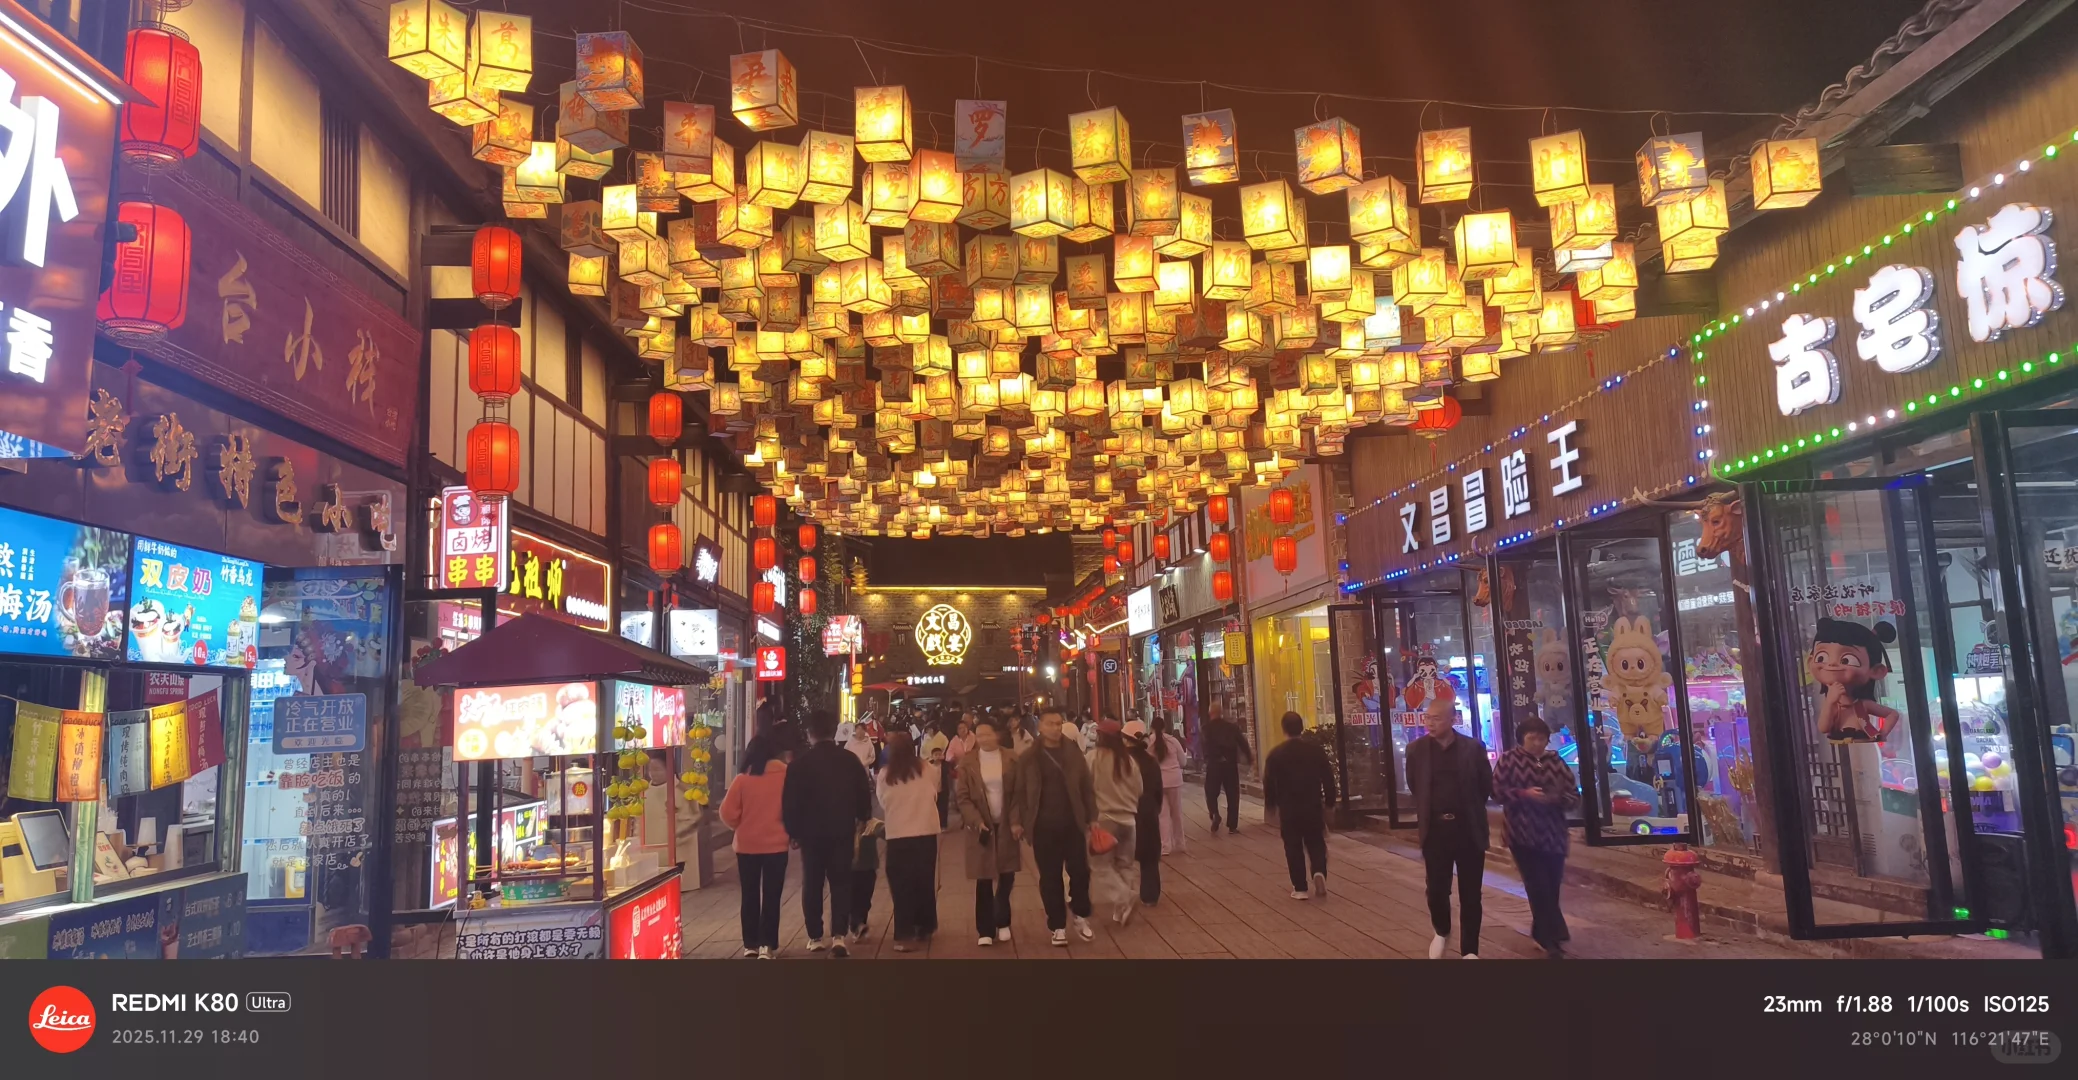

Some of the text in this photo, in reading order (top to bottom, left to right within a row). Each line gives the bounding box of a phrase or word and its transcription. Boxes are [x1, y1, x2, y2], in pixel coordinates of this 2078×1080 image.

[967, 109, 994, 149] 罗
[988, 173, 1009, 207] 方
[6, 307, 54, 384] 香
[1399, 419, 1583, 554] 文昌冒险王
[452, 528, 491, 552] 卤烤
[140, 557, 213, 596] 双皮奶
[220, 564, 254, 587] 竹香乌龙
[447, 553, 495, 588] 串串
[925, 612, 961, 632] 文昌
[1583, 636, 1604, 712] 正在营业
[149, 686, 184, 696] NONGFU SPRING
[285, 699, 355, 717] 冷气开放
[285, 716, 354, 733] 正在营业
[294, 737, 344, 747] 欢迎光临
